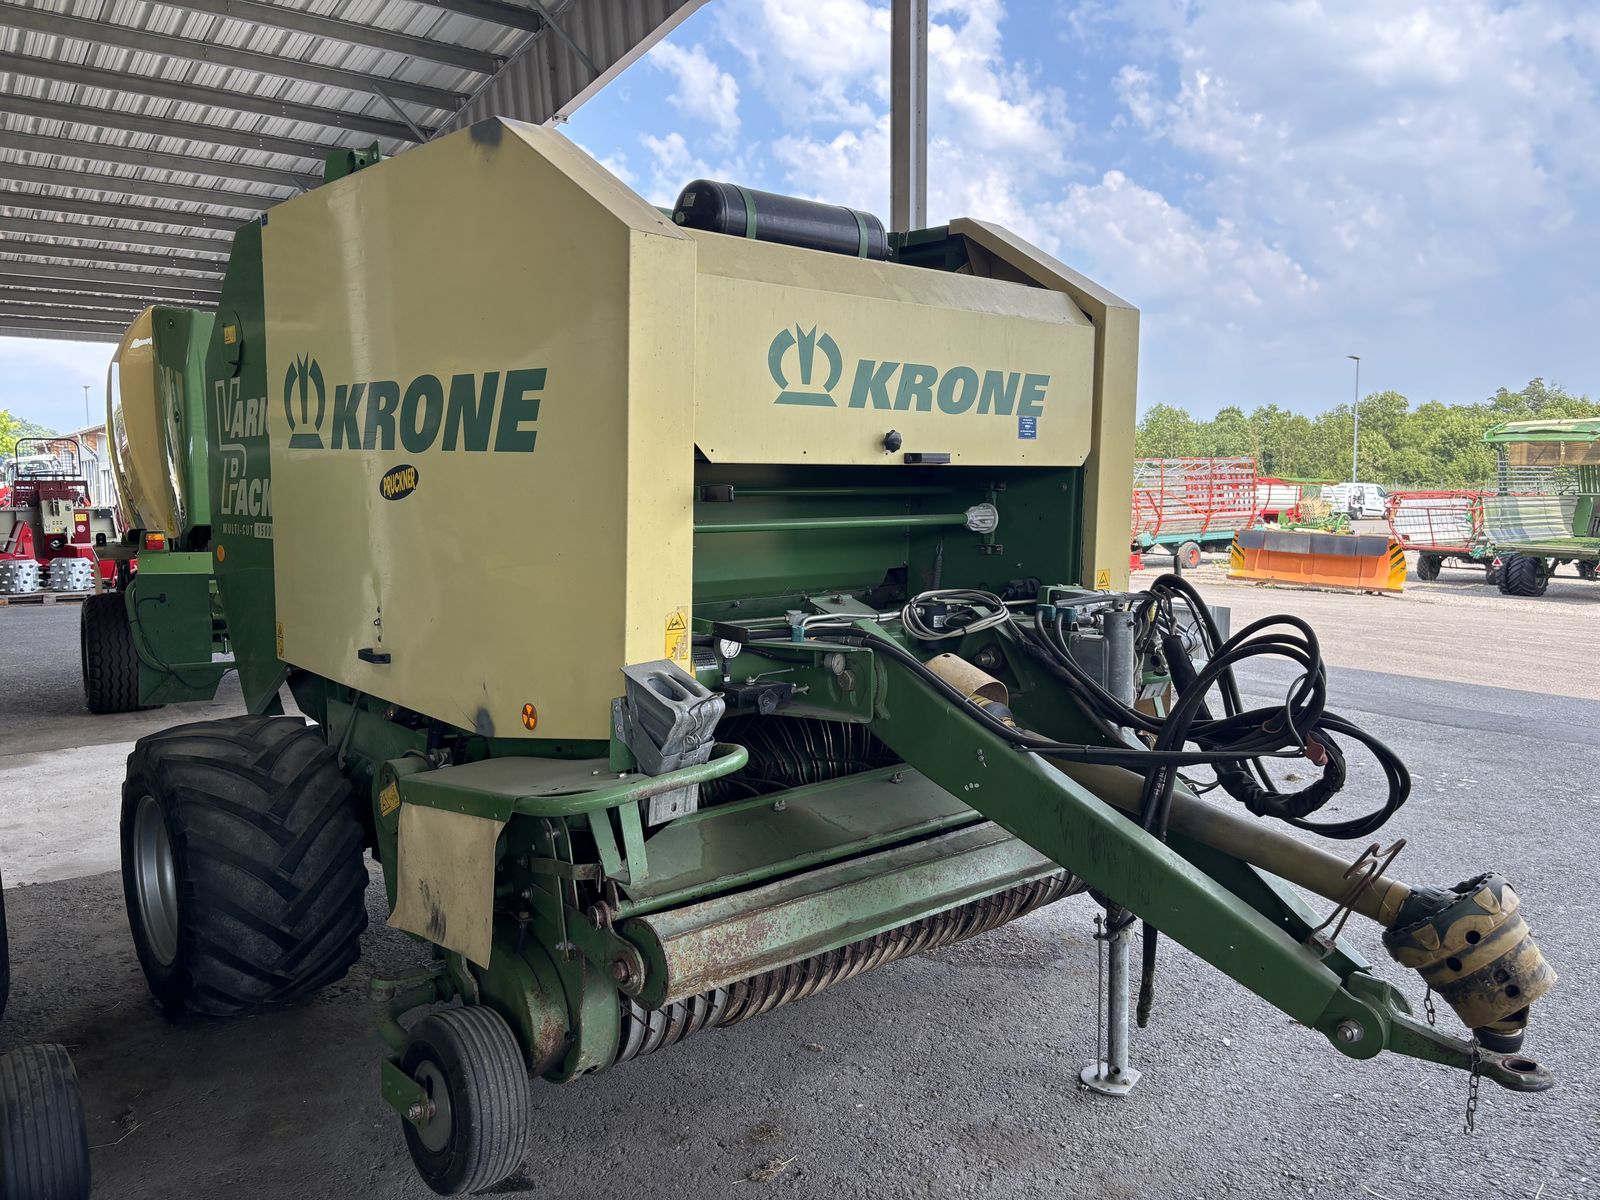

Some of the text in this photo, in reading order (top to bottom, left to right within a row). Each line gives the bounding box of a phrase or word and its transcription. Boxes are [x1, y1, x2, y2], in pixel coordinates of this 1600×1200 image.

[215, 377, 269, 438] VARI
[331, 368, 547, 453] KRONE
[848, 360, 1050, 416] KRONE
[383, 467, 416, 498] PRUCKNER
[223, 523, 253, 535] MULTI-CUT
